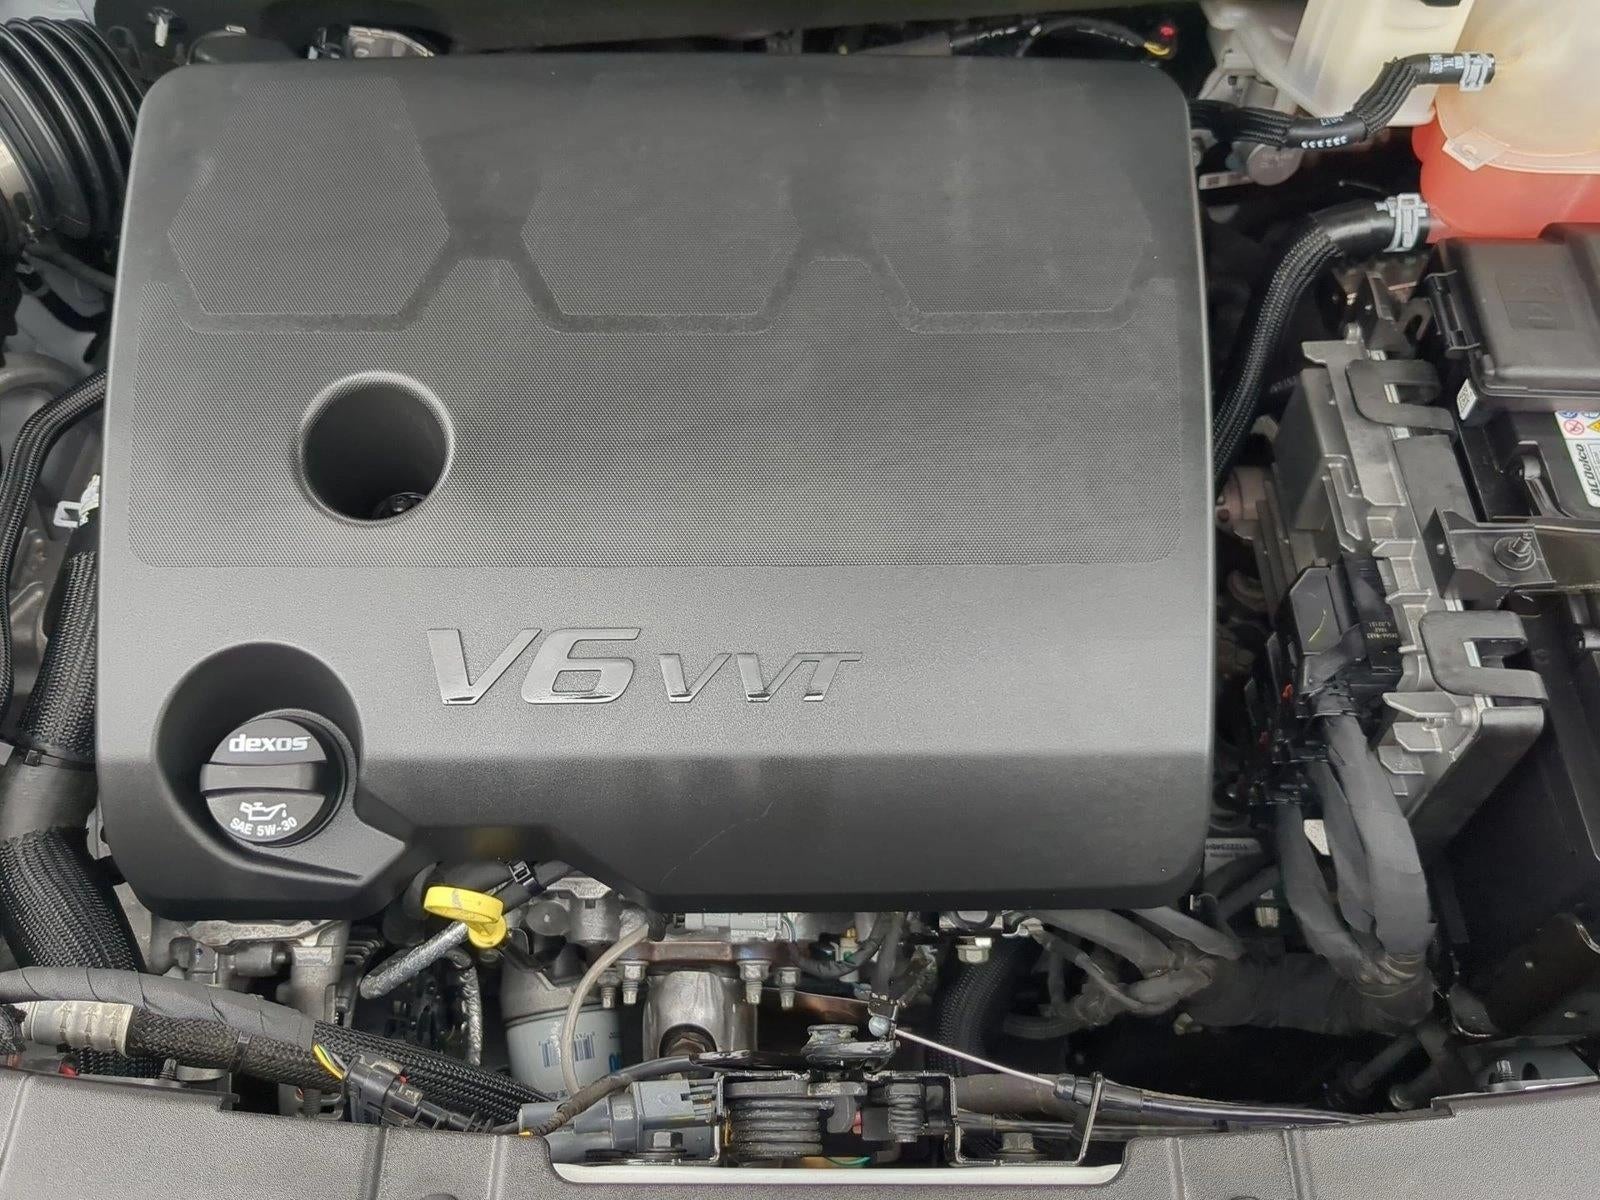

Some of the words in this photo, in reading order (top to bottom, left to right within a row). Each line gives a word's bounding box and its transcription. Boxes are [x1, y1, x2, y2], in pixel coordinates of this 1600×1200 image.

[427, 628, 641, 705] V6
[658, 652, 864, 703] VVT
[228, 733, 311, 752] dexos
[229, 817, 253, 835] SAE
[256, 817, 297, 836] 5W-30
